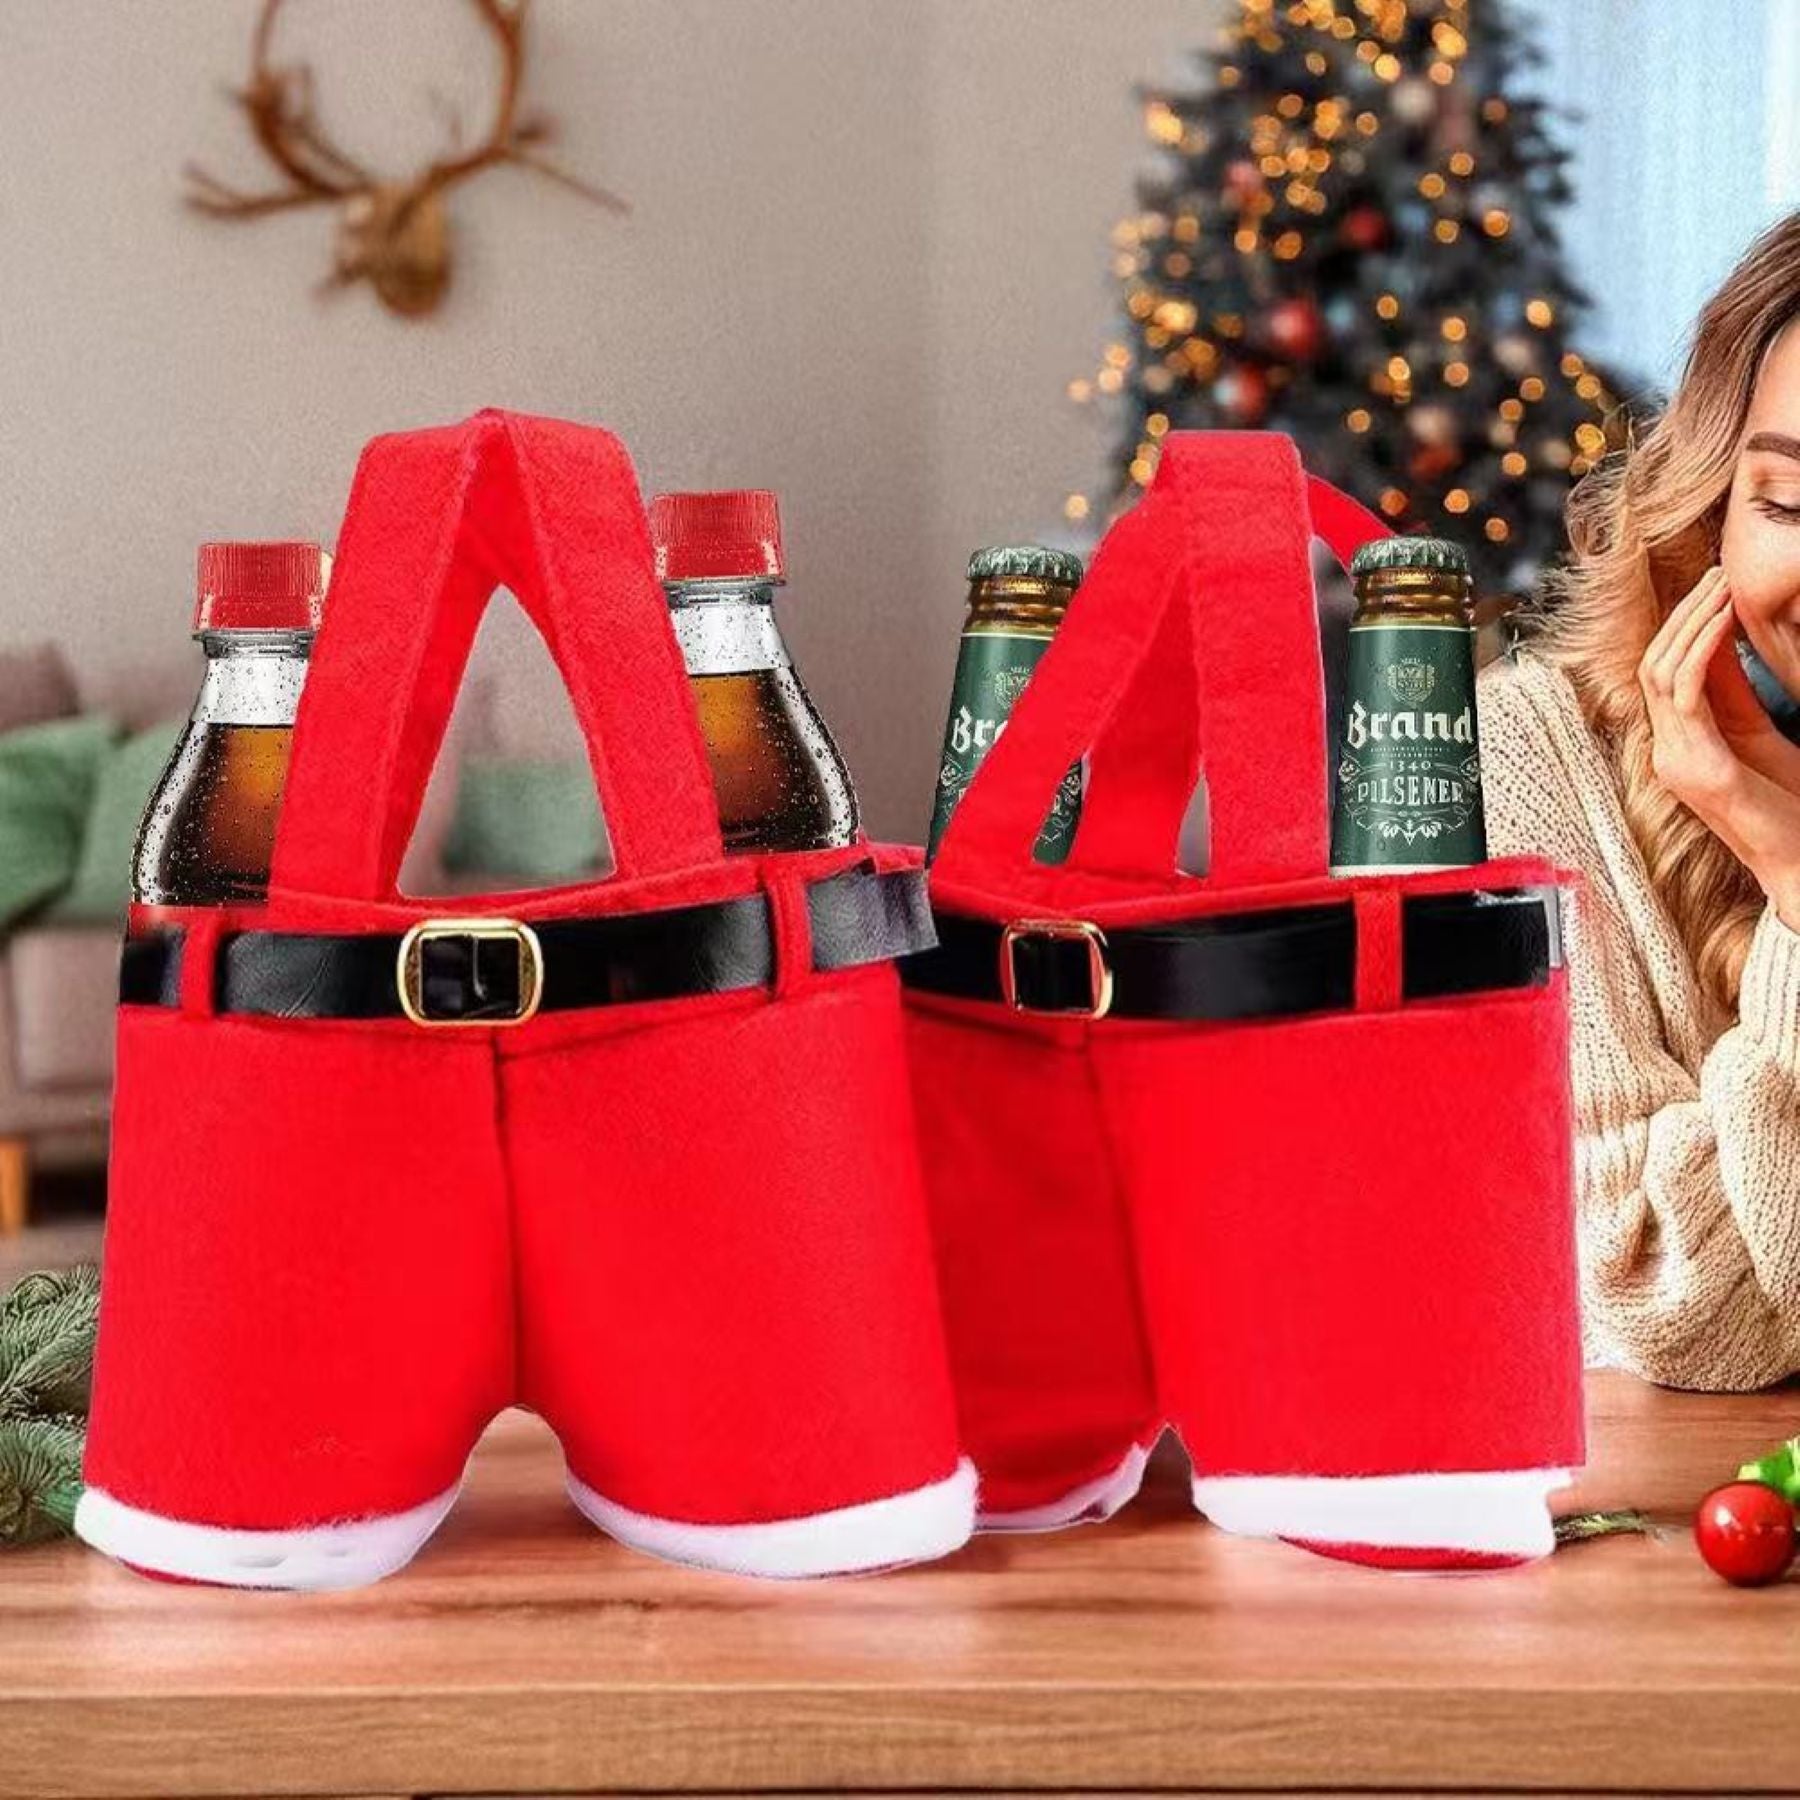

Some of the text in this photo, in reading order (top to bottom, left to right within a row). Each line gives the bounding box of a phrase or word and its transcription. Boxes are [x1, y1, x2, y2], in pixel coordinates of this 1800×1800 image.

[1347, 700, 1474, 749] Brand
[1389, 760, 1432, 773] 1340
[1357, 776, 1465, 807] PILSENER
